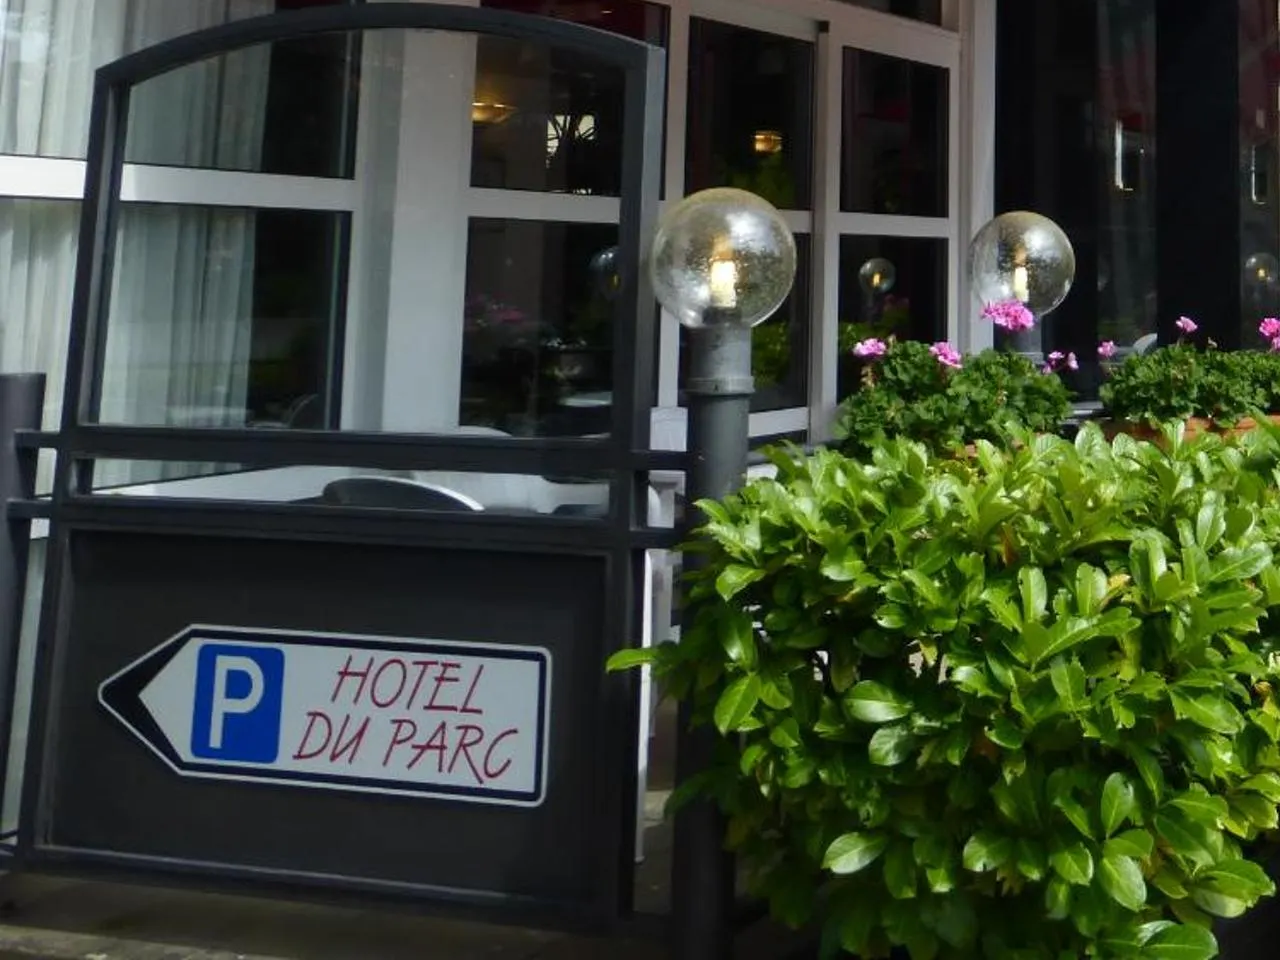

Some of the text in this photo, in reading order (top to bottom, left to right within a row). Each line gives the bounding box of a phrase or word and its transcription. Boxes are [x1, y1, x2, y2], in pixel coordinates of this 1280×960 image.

[209, 654, 265, 749] P
[330, 655, 484, 714] HOTEL
[292, 711, 519, 784] DU PARC
